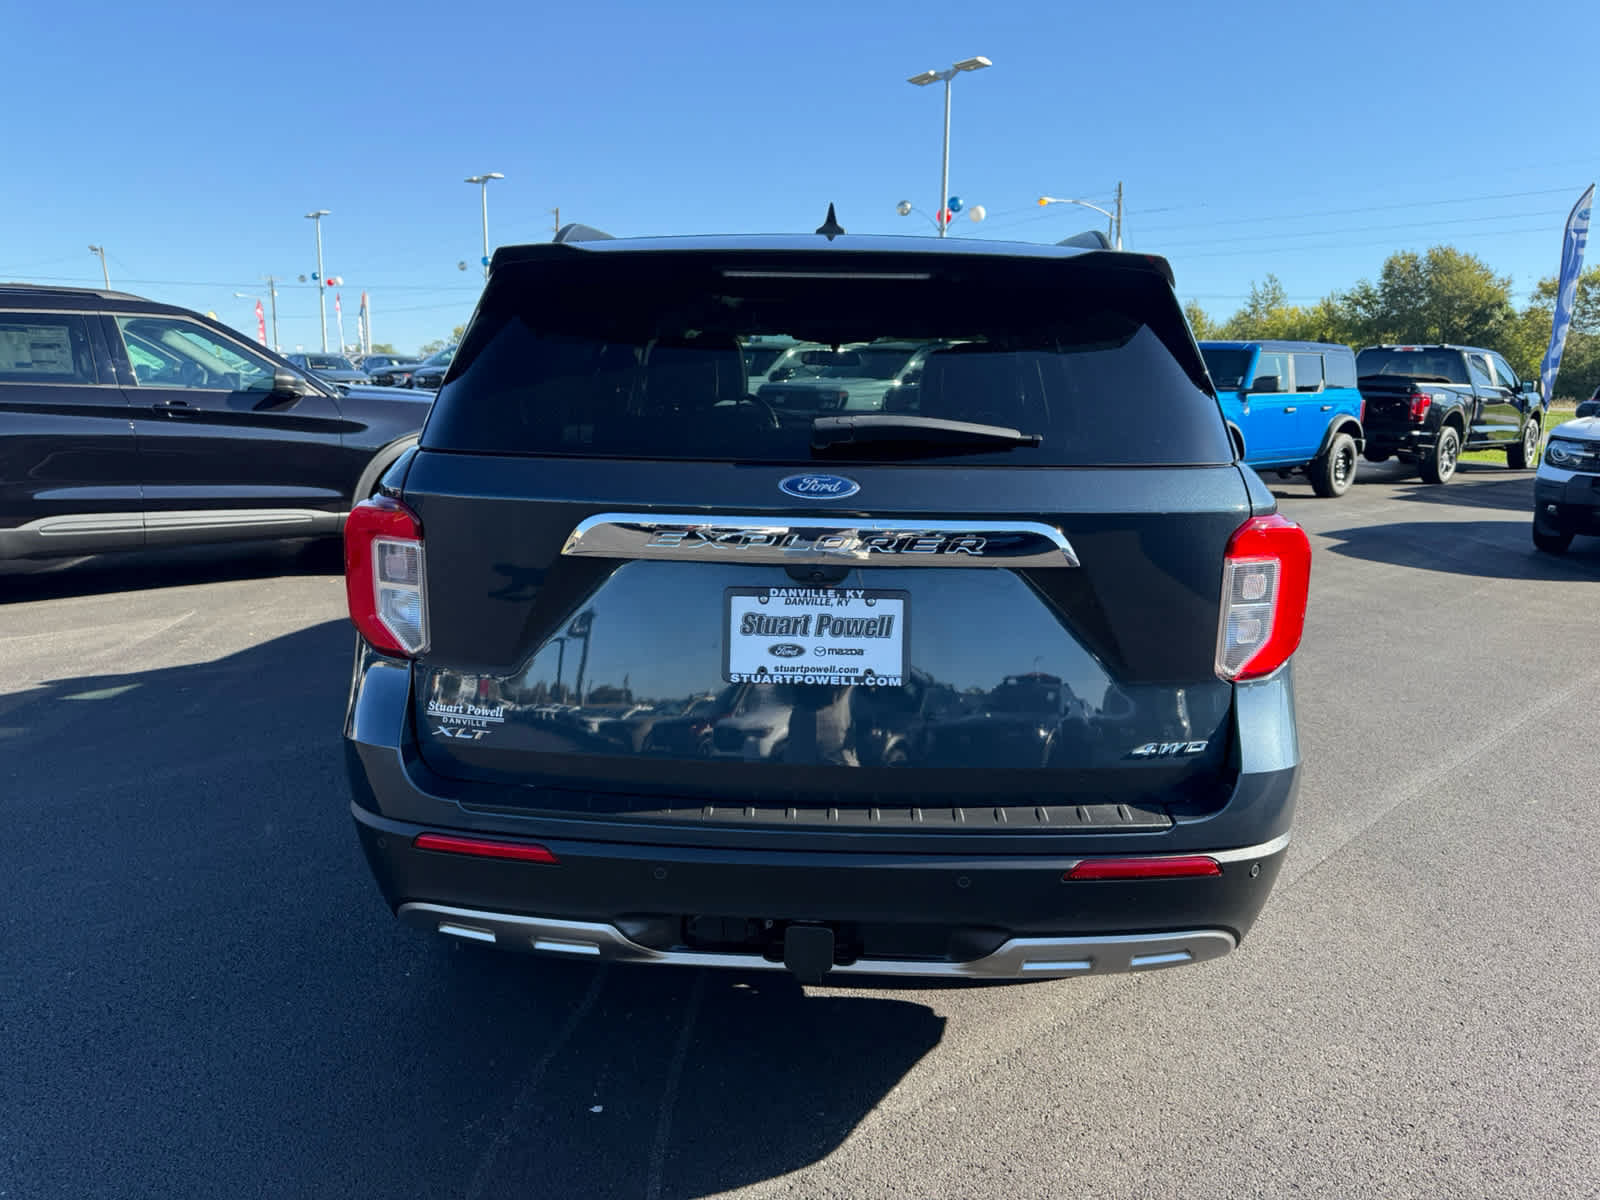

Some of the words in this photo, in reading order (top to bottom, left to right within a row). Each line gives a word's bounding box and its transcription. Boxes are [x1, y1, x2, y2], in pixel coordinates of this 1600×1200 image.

[798, 477, 842, 492] Ford
[646, 529, 988, 555] EXPLORER
[769, 588, 840, 599] DANVILLE,
[846, 589, 865, 599] KY
[784, 598, 834, 608] DANVILLE,
[836, 599, 850, 607] KY
[740, 612, 811, 637] Stuart
[815, 613, 895, 639] Powell
[775, 645, 800, 657] Ford
[774, 665, 859, 674] stuartpowell.com
[730, 674, 902, 686] STUARTPOWELL.COM
[428, 700, 463, 713] Stuart
[467, 704, 504, 717] Powell
[442, 716, 487, 727] DANVILLE
[431, 725, 492, 740] XLT
[1132, 740, 1209, 755] 4WD
